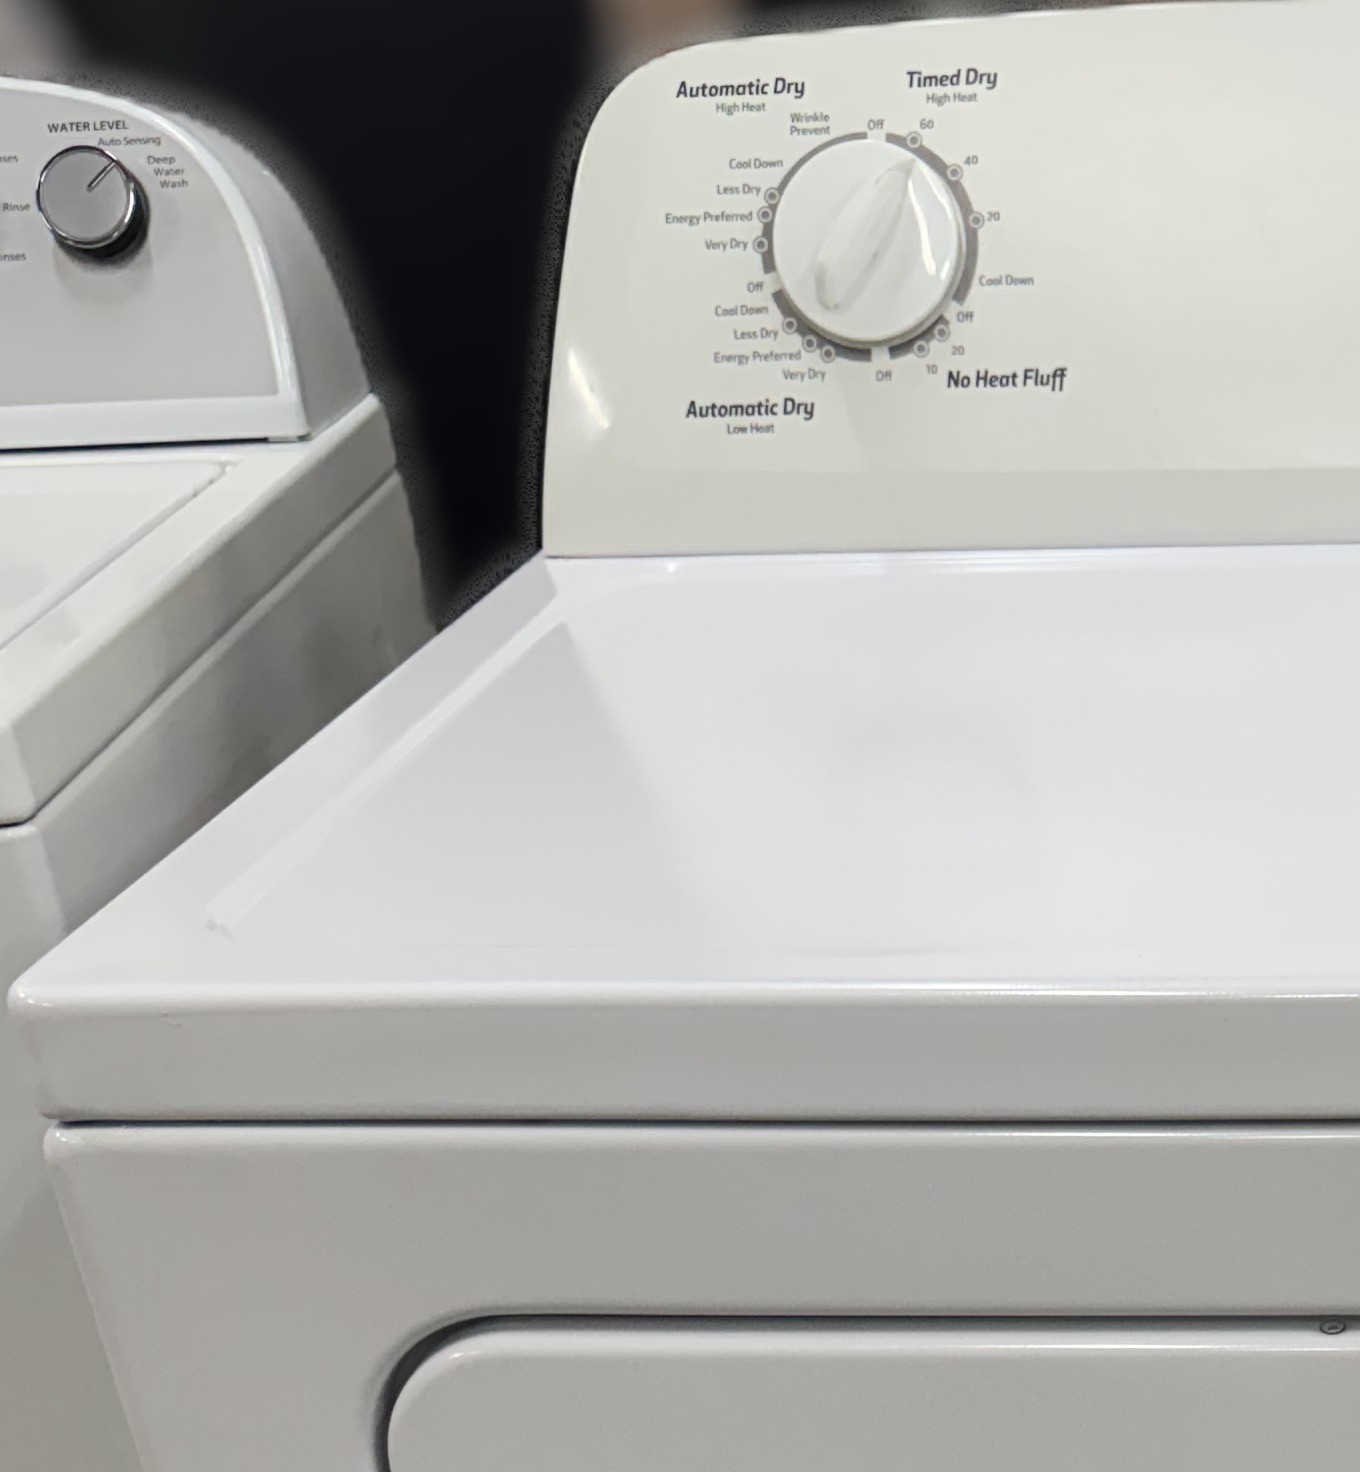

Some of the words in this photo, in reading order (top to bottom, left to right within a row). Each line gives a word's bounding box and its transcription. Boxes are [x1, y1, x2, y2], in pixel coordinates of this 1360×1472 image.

[907, 69, 961, 88] Timed
[965, 68, 997, 90] Dry
[676, 79, 769, 98] Automatic
[774, 77, 805, 99] Dry
[926, 92, 950, 107] High
[953, 92, 977, 102] Heat
[716, 102, 740, 116] High
[742, 102, 766, 112] Heat
[790, 112, 830, 123] Wrinkle
[48, 122, 90, 133] WATER
[93, 120, 128, 131] LEVEL
[867, 119, 885, 131] Off
[920, 119, 934, 129] 60
[790, 125, 830, 136] Prevent
[98, 137, 122, 147] Auto
[123, 137, 161, 146] Sensing
[146, 155, 176, 165] Deep
[729, 158, 752, 169] Cool
[754, 158, 783, 169] Down
[964, 155, 978, 166] 40
[153, 167, 185, 177] Water
[160, 179, 188, 189] Wash
[717, 184, 740, 195] Less
[742, 183, 761, 196] Dry
[1, 203, 30, 212] Rinse
[665, 213, 702, 226] Energy
[703, 210, 753, 222] Preferred
[987, 211, 1000, 222] 20
[705, 239, 728, 252] Very
[730, 238, 748, 252] Dry
[979, 275, 1003, 286] Cool
[1005, 274, 1034, 286] Down
[747, 281, 764, 293] Off
[715, 305, 738, 317] Cool
[740, 305, 769, 315] Down
[956, 311, 974, 323] Off
[734, 329, 758, 340] Less
[760, 327, 779, 341] Dry
[951, 345, 965, 355] 20
[714, 351, 750, 366] Energy
[752, 350, 802, 362] Preferred
[782, 369, 806, 382] Very
[807, 368, 826, 382] Dry
[926, 364, 938, 374] 10
[876, 370, 892, 381] Off
[947, 370, 971, 388] No
[976, 370, 1018, 388] Heat
[1023, 367, 1067, 392] Fluff
[686, 399, 778, 418] Automatic
[783, 397, 814, 421] Dry
[727, 424, 748, 434] Low
[750, 423, 774, 433] Heat
